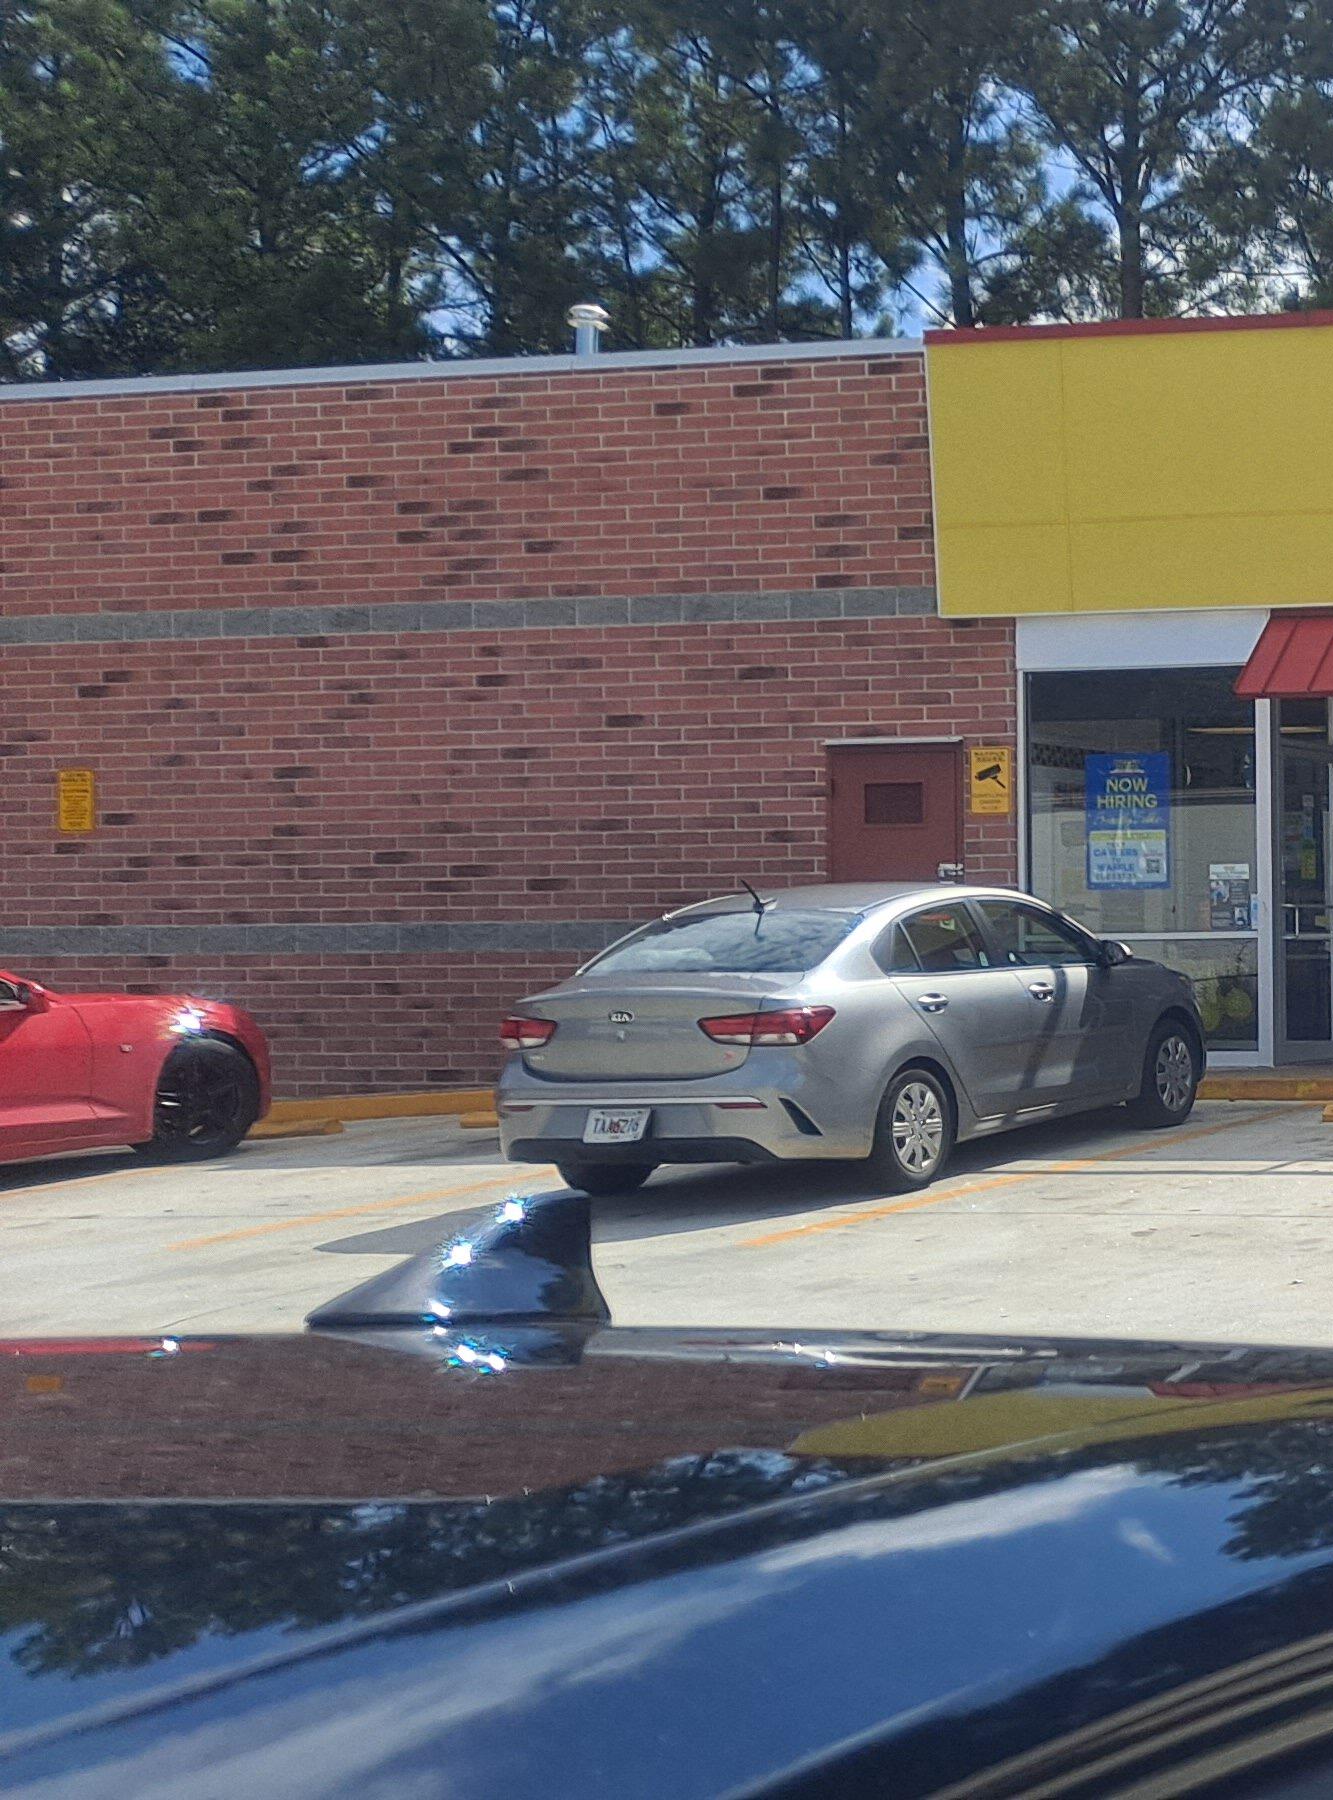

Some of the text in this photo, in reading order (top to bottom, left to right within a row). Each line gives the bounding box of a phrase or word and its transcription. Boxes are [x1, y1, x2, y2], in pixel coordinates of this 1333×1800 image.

[1106, 777, 1149, 794] NOW
[1097, 793, 1158, 809] HIRING
[610, 1013, 630, 1022] KIA
